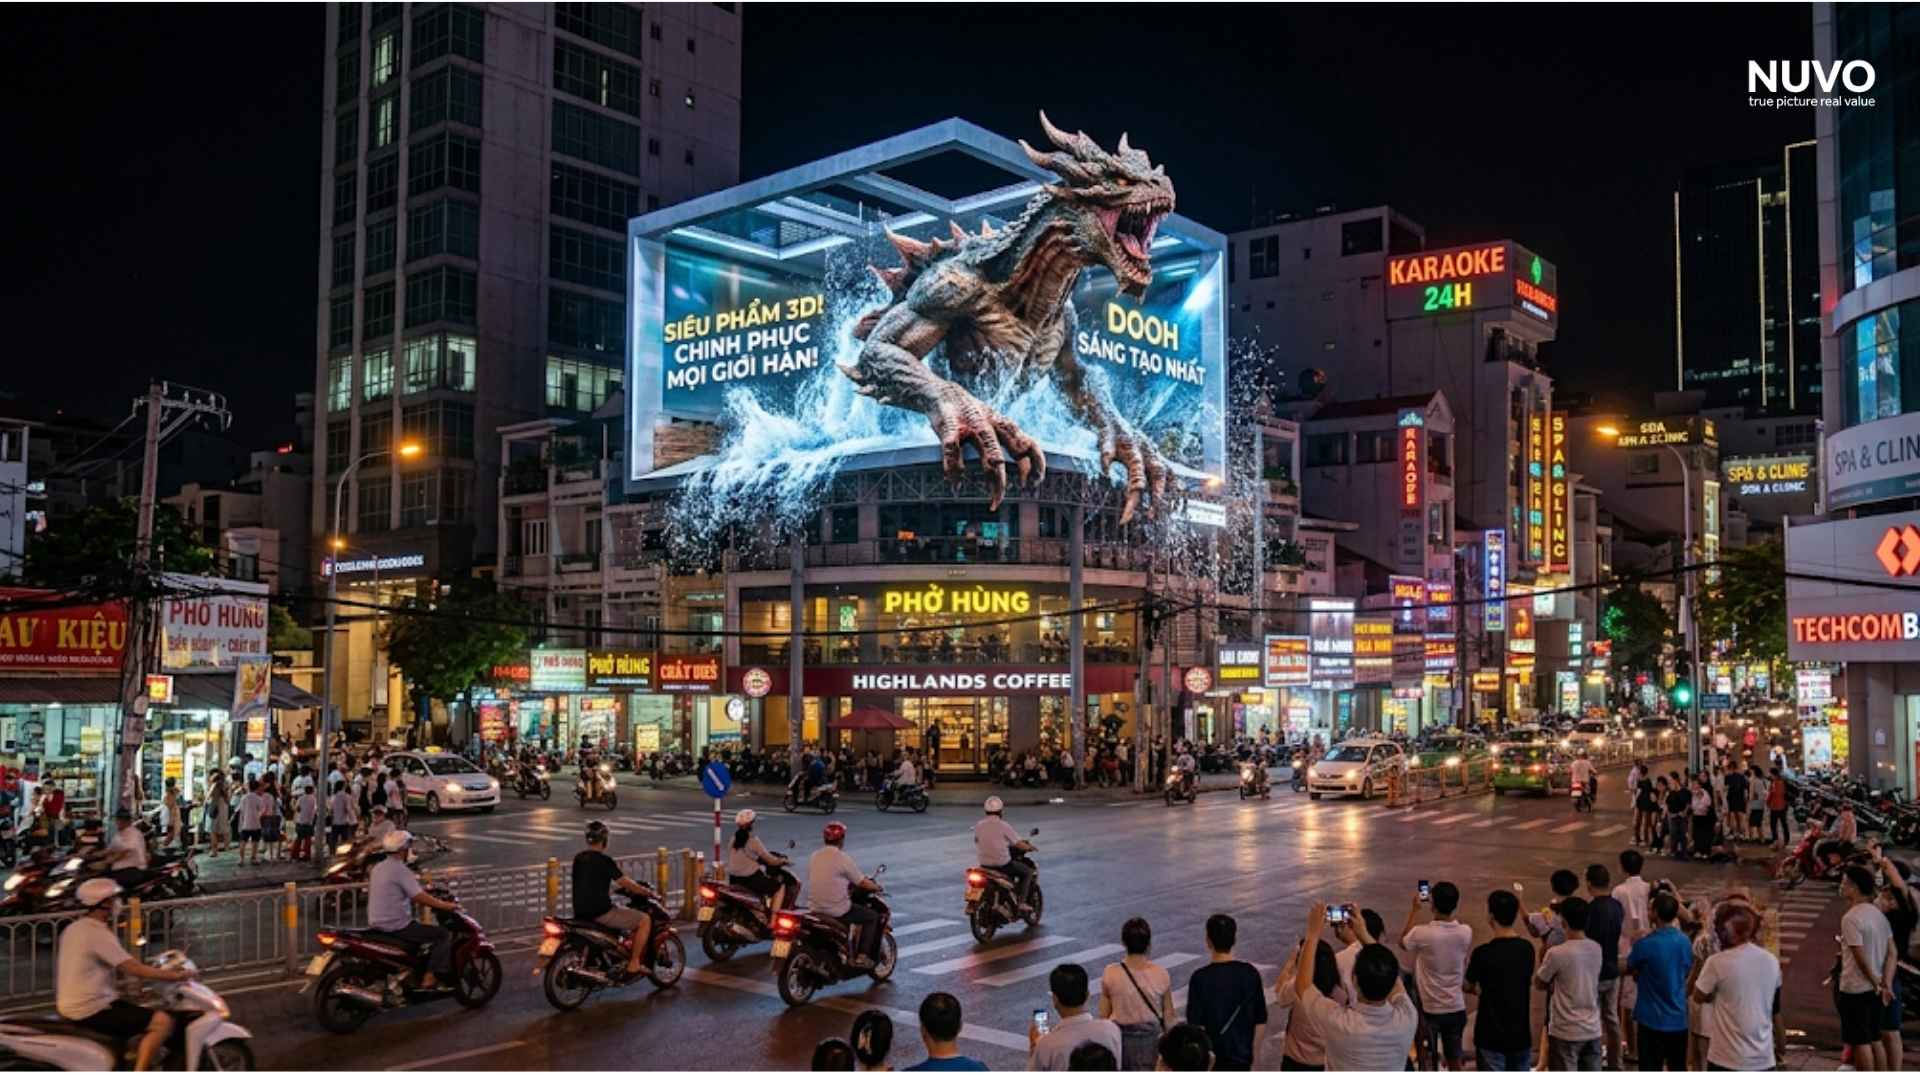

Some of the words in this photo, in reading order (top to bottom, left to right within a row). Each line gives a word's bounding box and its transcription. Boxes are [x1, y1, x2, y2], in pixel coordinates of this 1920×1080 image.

[1390, 246, 1505, 286] KARAOKE
[786, 294, 824, 321] 3D!
[1423, 282, 1472, 311] 24H
[674, 335, 741, 364] CHINH
[747, 323, 811, 352] PHỤC
[1107, 302, 1178, 351] DOOH
[667, 365, 707, 391] MỌI
[762, 346, 819, 377] HẠN!
[1078, 330, 1127, 365] SÁNG
[1129, 346, 1162, 376] TẠO
[1834, 447, 1857, 477] SPA
[1860, 444, 1873, 470] &
[884, 583, 944, 613] PHỞ
[951, 585, 1030, 613] HÙNG
[57, 611, 127, 656] KIỆU
[852, 673, 987, 690] HIGHLANDS
[993, 673, 1072, 690] COFFEE
